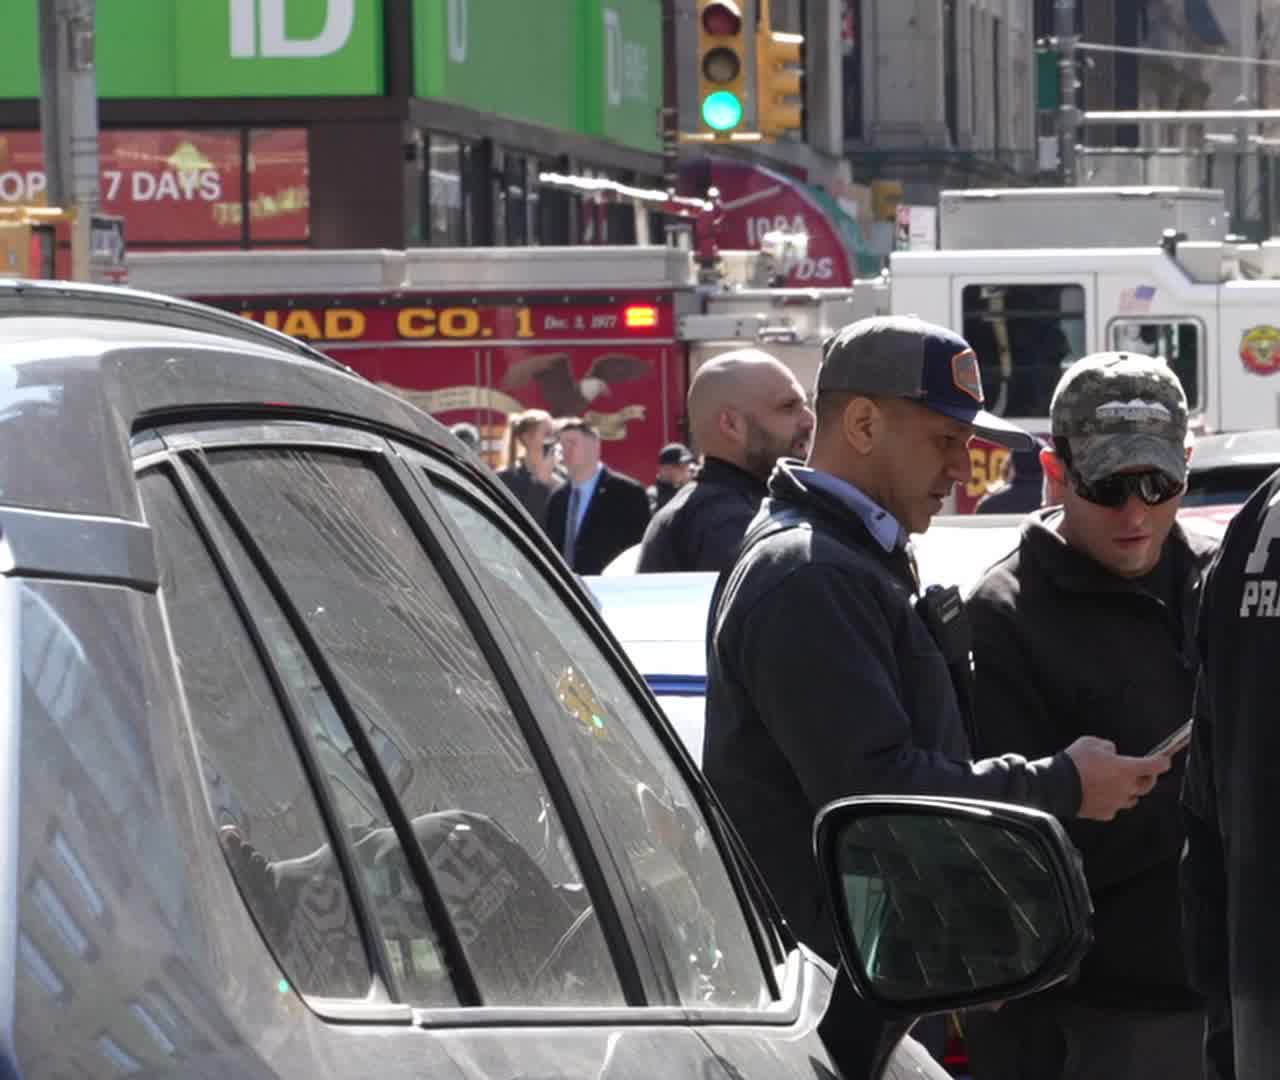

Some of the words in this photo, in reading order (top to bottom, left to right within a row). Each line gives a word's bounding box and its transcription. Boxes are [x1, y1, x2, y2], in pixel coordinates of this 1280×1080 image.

[102, 171, 122, 200] 7
[132, 171, 222, 201] DAYS
[397, 308, 493, 337] CO.
[516, 308, 536, 337] 1
